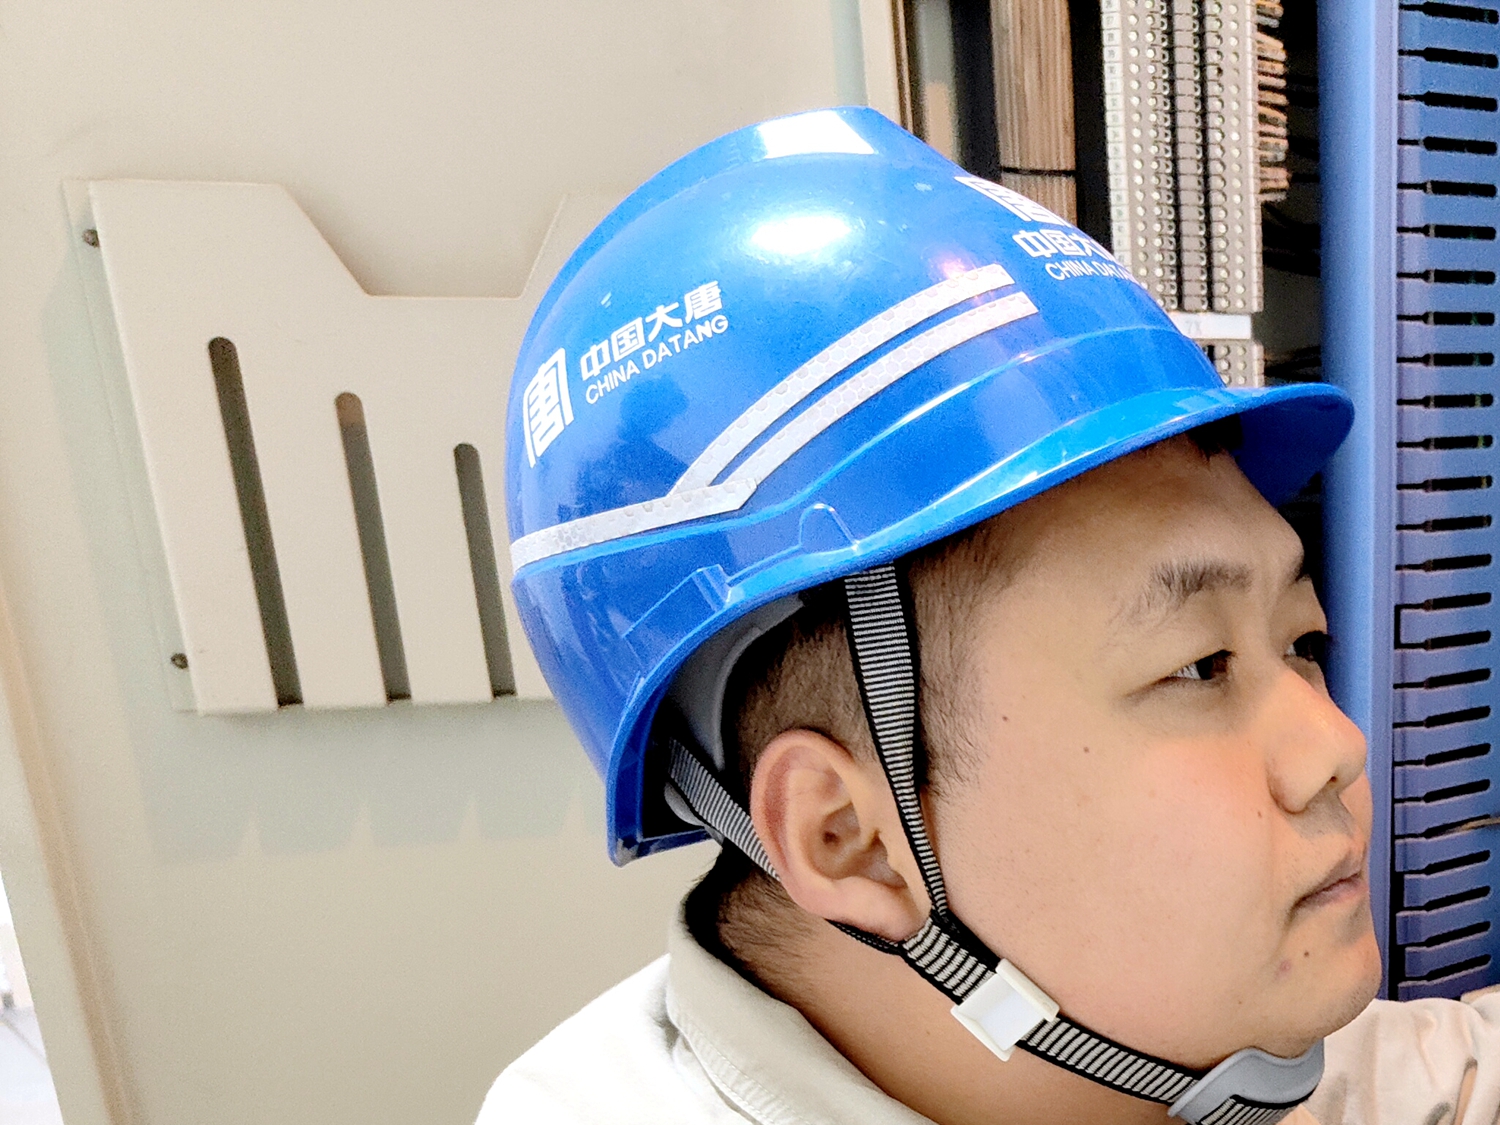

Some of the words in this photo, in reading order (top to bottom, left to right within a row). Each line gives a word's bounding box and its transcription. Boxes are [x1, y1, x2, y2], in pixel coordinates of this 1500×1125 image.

[1012, 229, 1115, 260] 中国大
[1045, 260, 1100, 280] CHINA
[580, 280, 723, 382] 中国大唐
[585, 359, 641, 405] CHINA
[642, 314, 729, 369] DATANG
